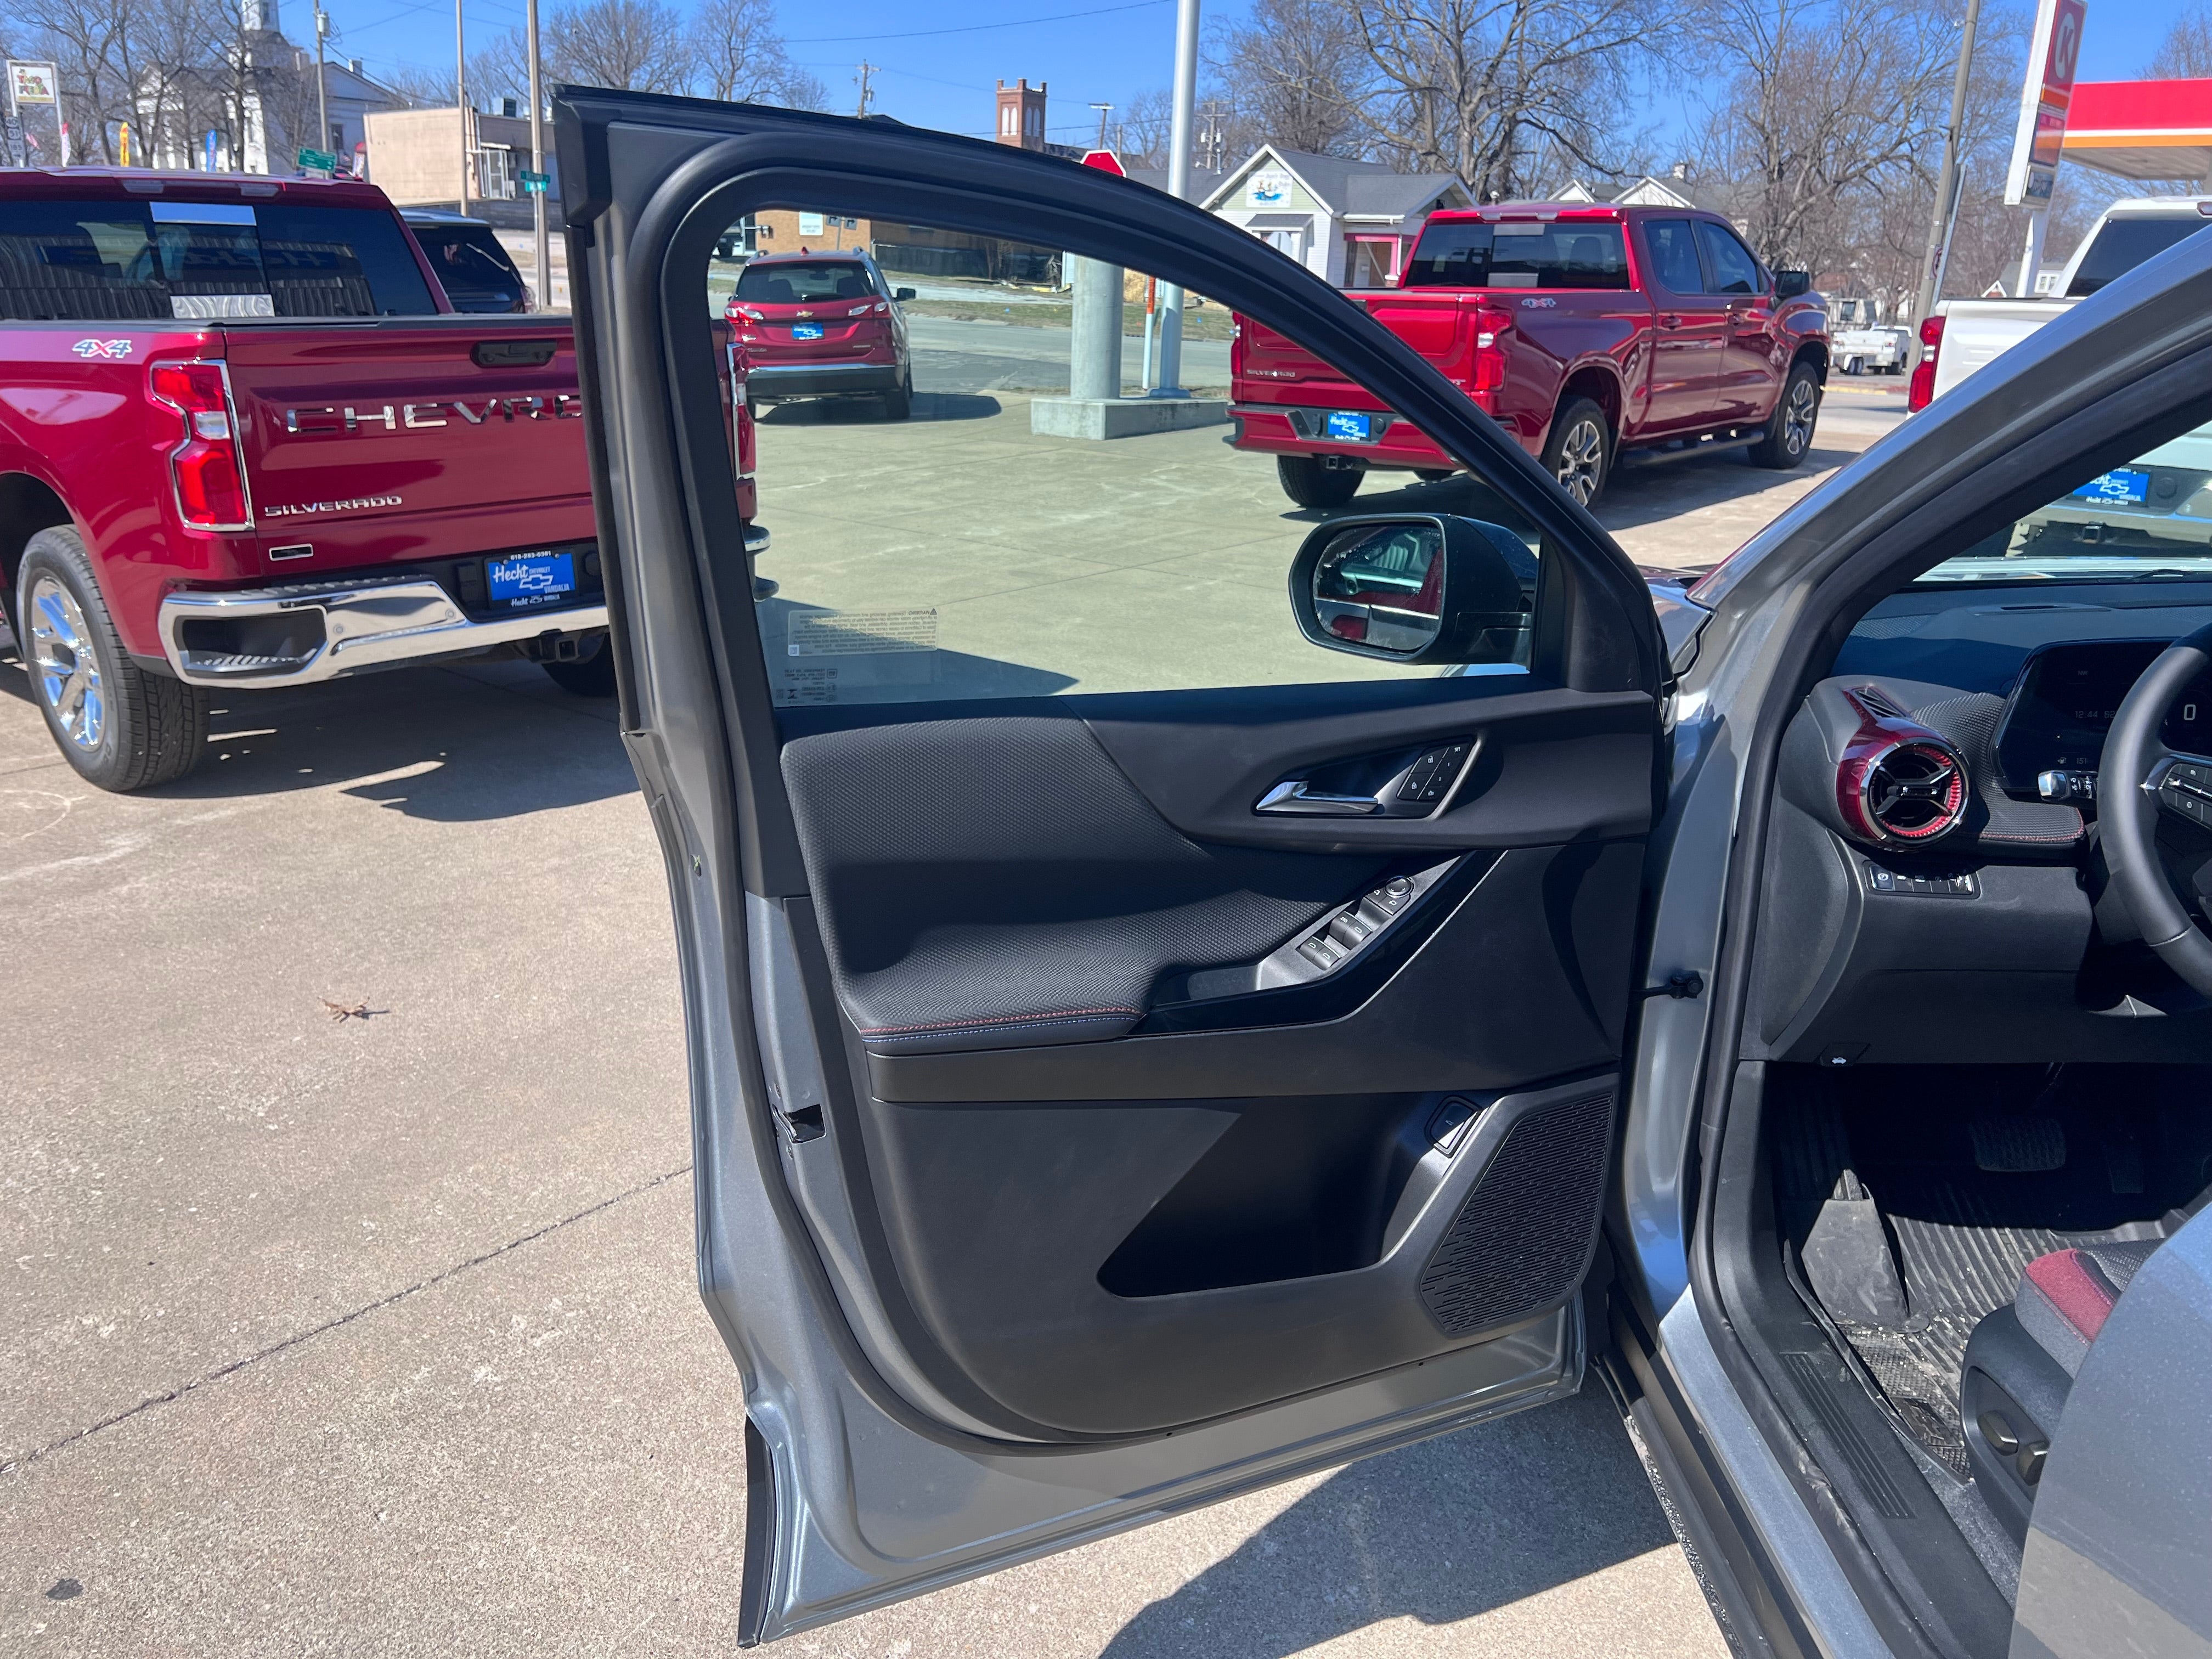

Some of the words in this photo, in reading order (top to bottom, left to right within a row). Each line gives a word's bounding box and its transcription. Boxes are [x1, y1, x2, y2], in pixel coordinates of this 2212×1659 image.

[264, 495, 402, 516] SILVERADO
[493, 563, 529, 583] Hecht
[2075, 710, 2098, 719] 12:44
[2183, 704, 2196, 720] 0
